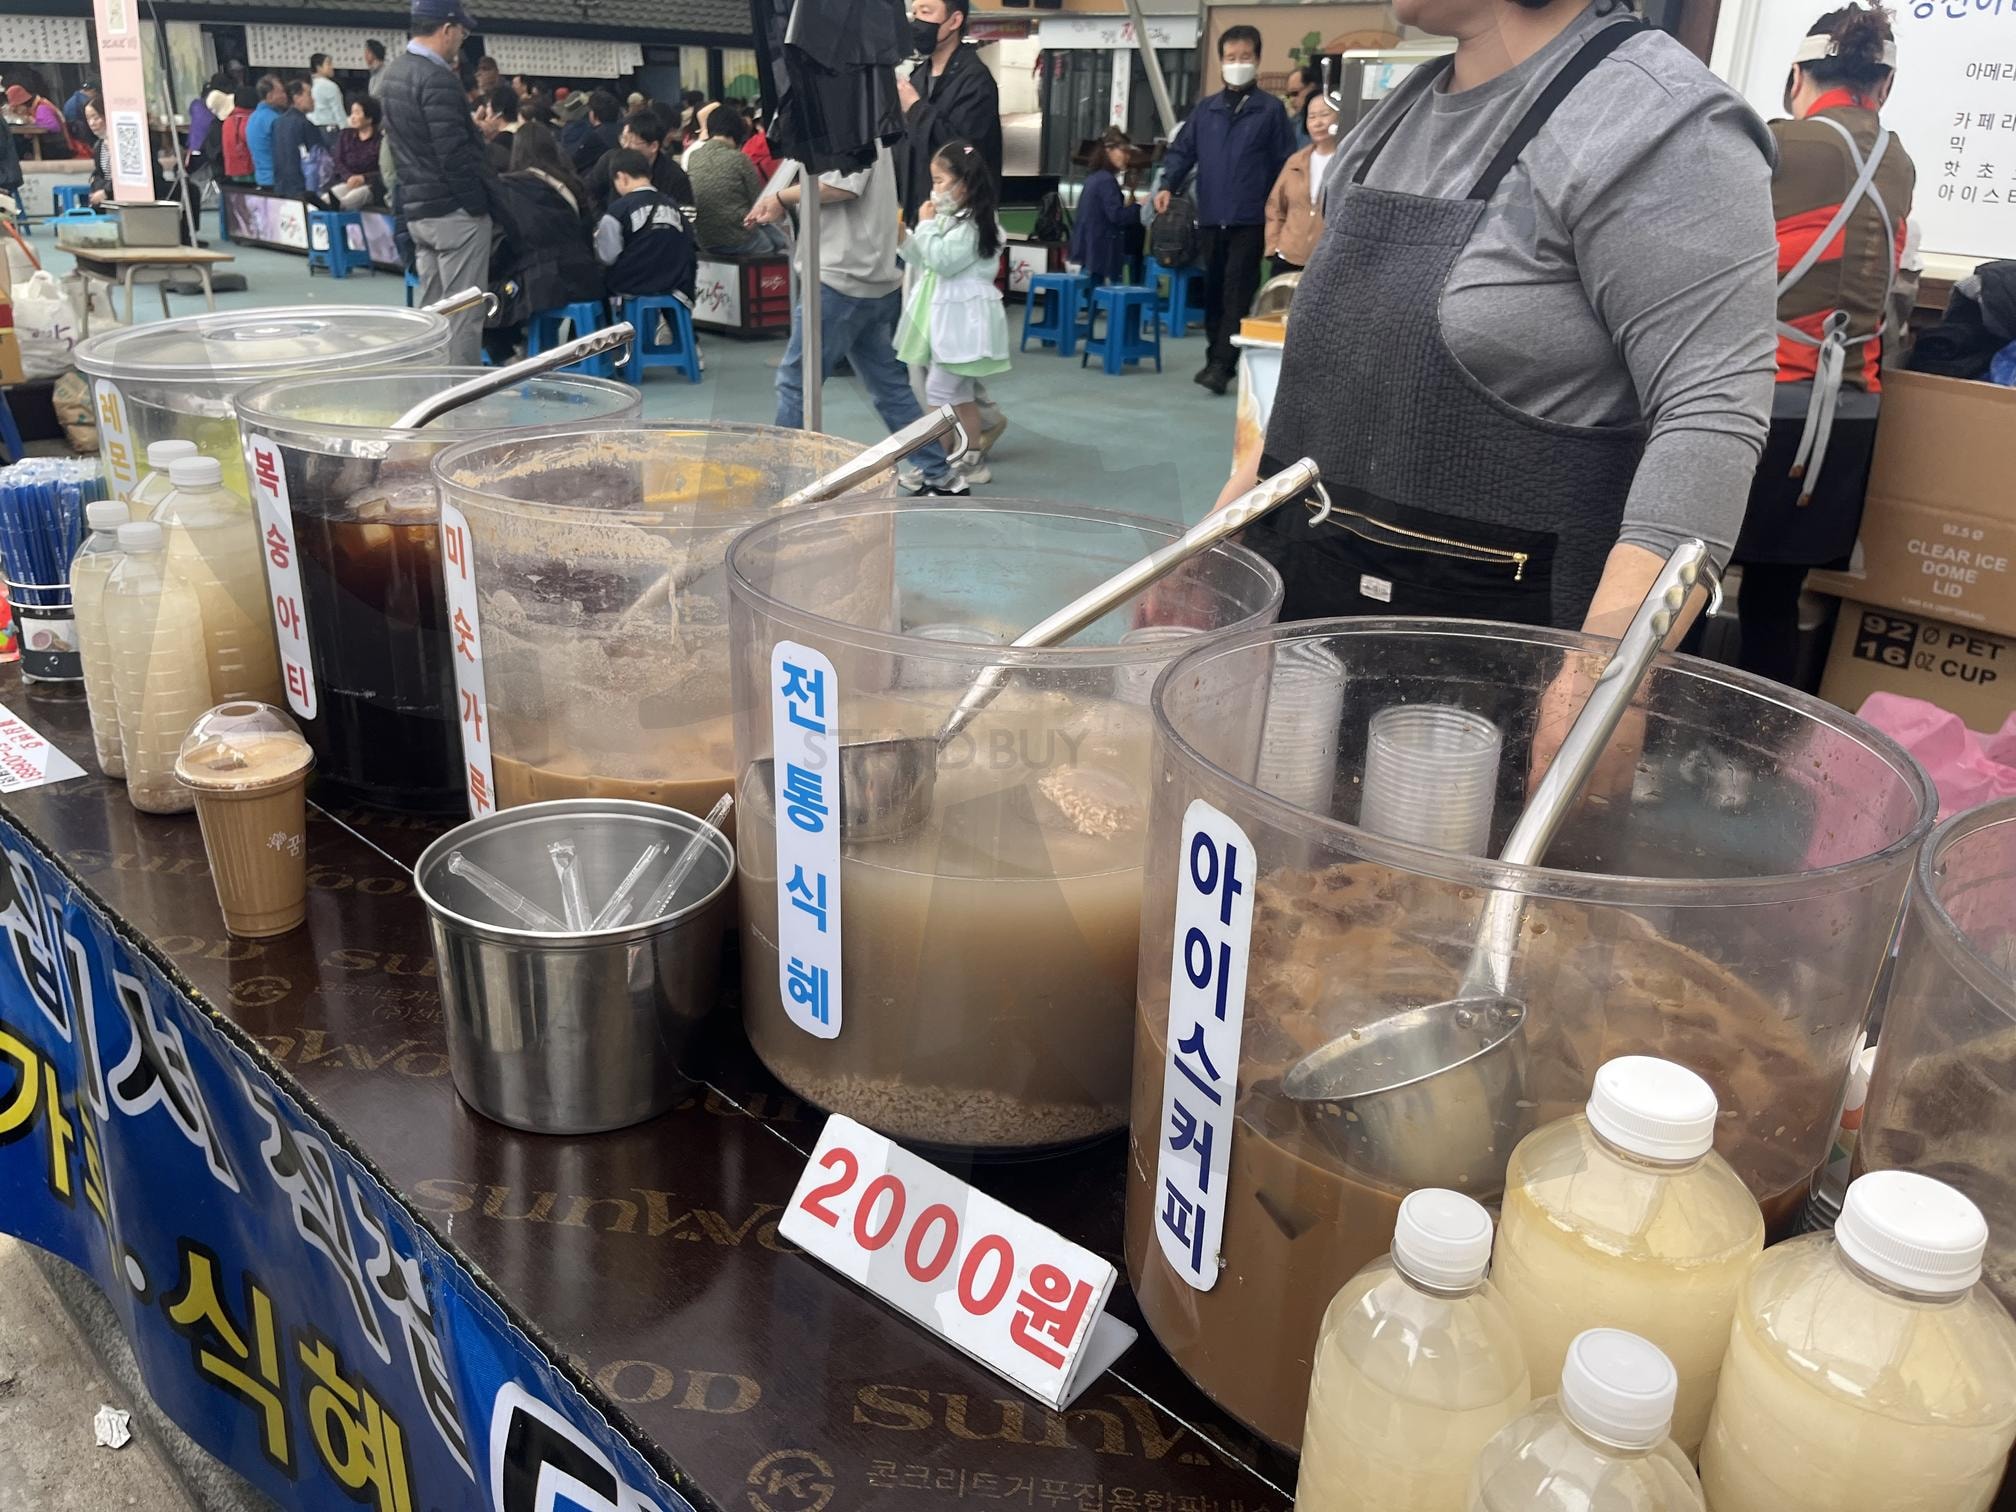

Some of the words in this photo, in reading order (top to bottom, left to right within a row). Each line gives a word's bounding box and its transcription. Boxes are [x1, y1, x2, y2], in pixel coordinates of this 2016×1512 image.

[1907, 539, 1970, 565] CLEAR
[1975, 553, 2008, 573] ICE
[1922, 559, 1979, 584] DOME
[1932, 578, 1963, 598] LID
[1863, 614, 1913, 642] 92
[1948, 632, 2005, 660] PET
[445, 524, 490, 814] 미숫가루
[1860, 640, 1907, 666] 16
[1940, 659, 1998, 685] CUP
[1162, 831, 1243, 1275] 아이스커피
[800, 1146, 1095, 1370] 2000원
